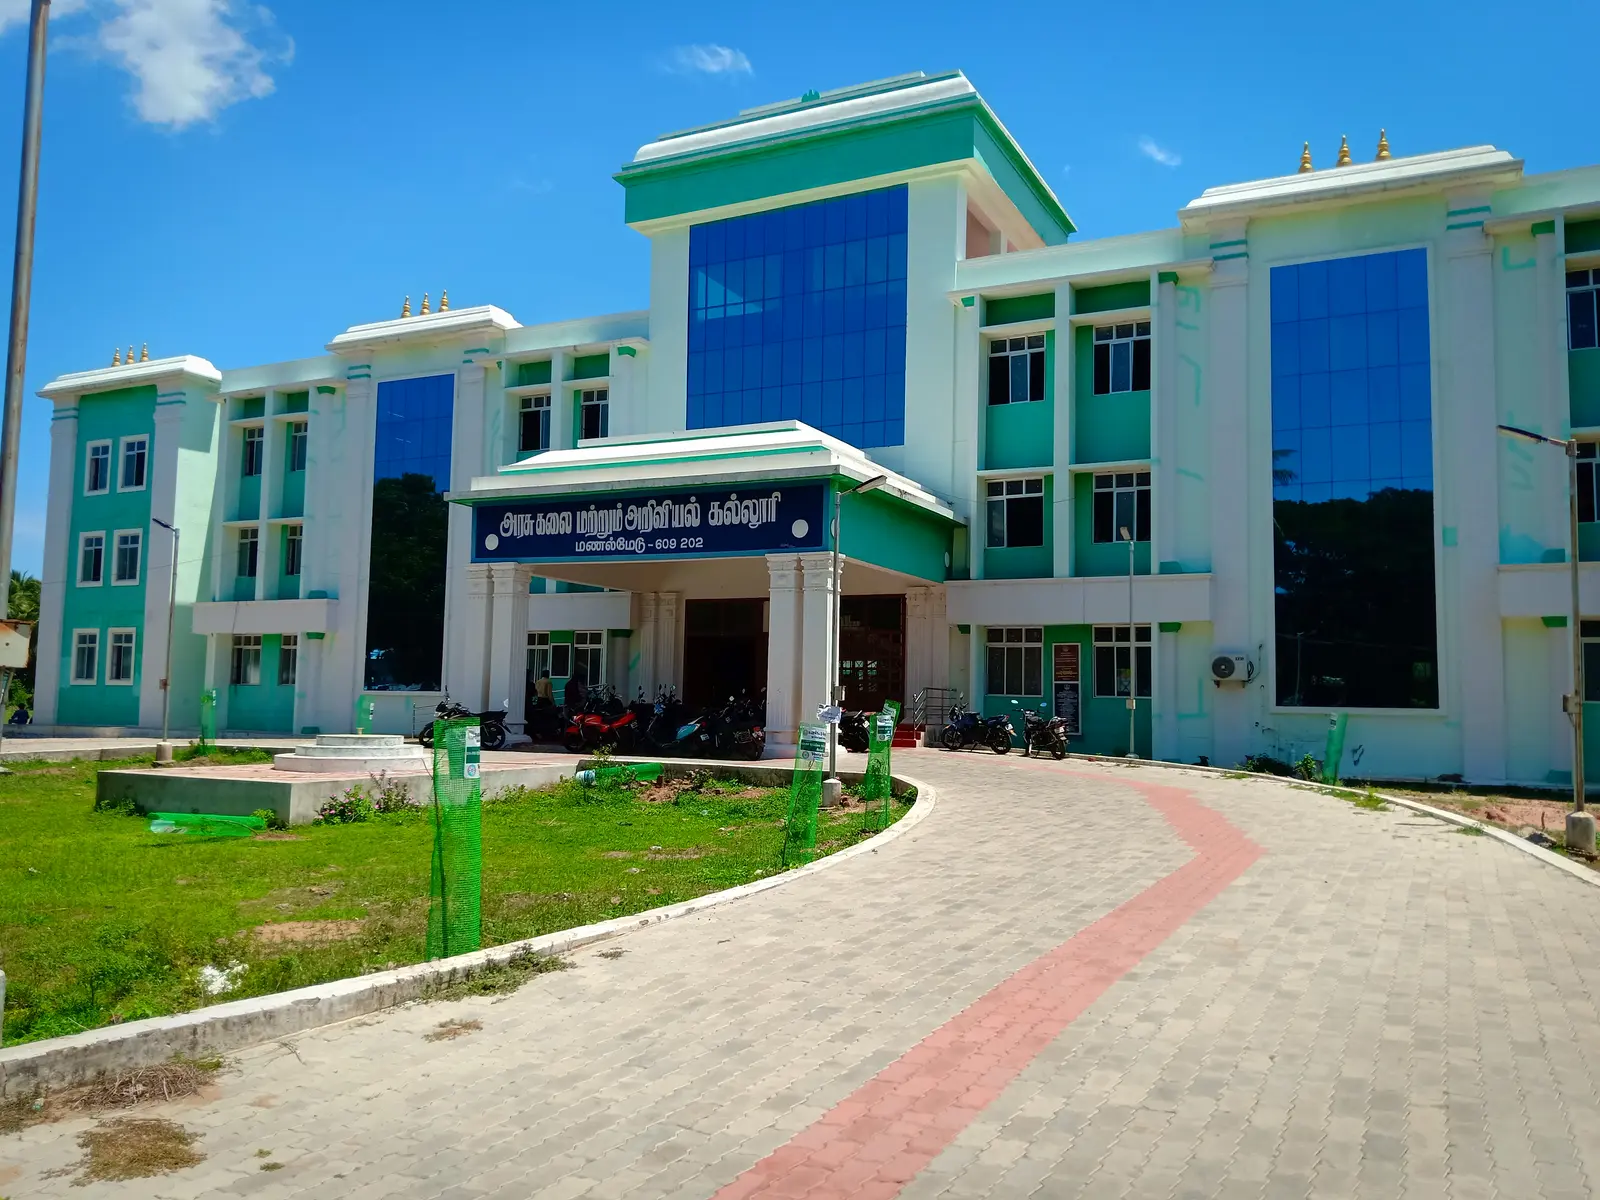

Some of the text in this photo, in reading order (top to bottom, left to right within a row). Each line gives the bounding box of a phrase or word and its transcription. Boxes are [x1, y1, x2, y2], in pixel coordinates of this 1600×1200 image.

[500, 491, 782, 539] அரசு கலை மற்றும் அறிவியல் கல்லூரி
[680, 537, 704, 549] 202
